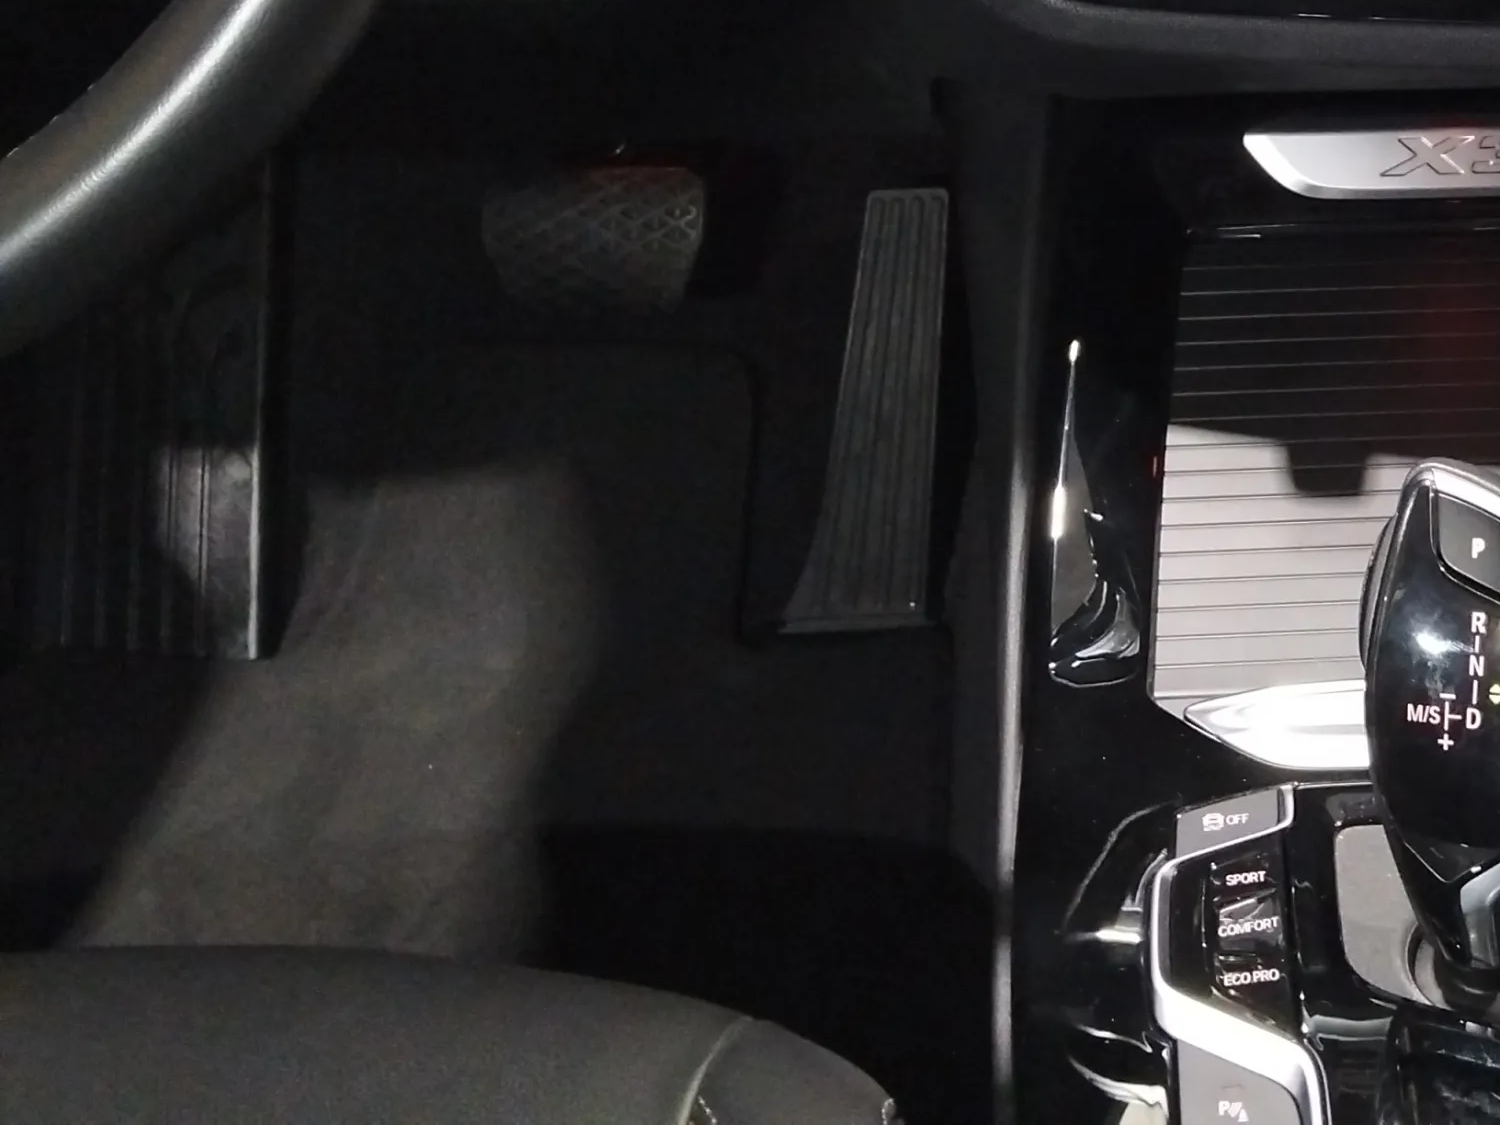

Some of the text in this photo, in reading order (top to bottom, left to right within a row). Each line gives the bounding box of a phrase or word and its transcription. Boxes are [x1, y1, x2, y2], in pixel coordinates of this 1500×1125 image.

[1471, 537, 1486, 559] P
[1470, 611, 1487, 634] R
[1468, 655, 1485, 677] N
[1406, 703, 1482, 730] M/S D
[1225, 813, 1250, 826] OFF
[1225, 870, 1267, 887] SPORT
[1218, 916, 1280, 937] COMFORT
[1223, 967, 1280, 987] ECO PRO
